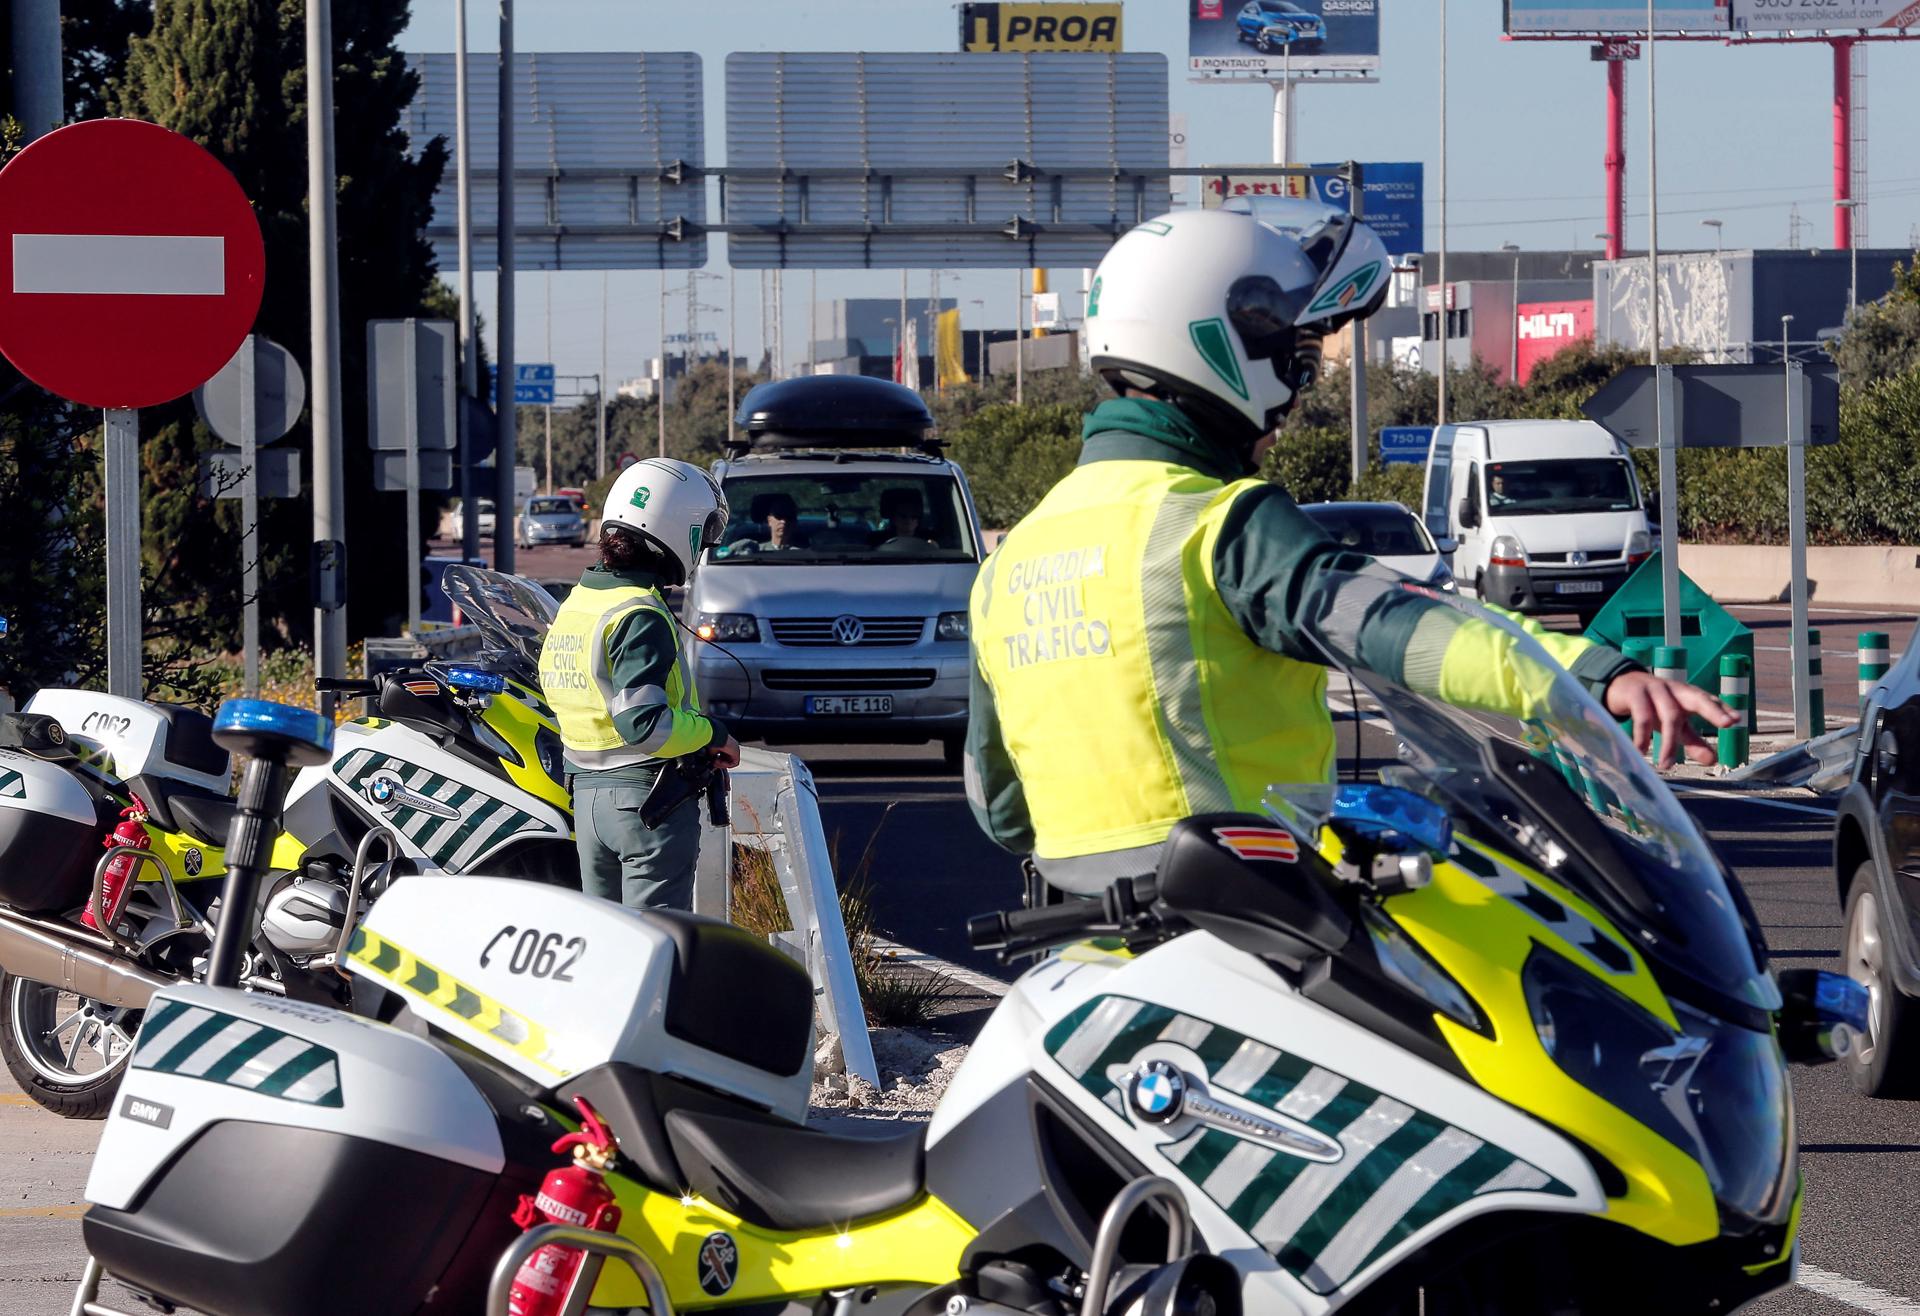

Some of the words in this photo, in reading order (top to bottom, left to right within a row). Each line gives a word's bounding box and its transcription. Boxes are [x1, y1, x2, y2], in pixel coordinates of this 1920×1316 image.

[1006, 16, 1117, 43] PROA
[1608, 43, 1637, 56] SPS
[1203, 59, 1266, 68] MONTAUTO
[1519, 313, 1574, 339] HILTI
[1392, 434, 1414, 444] 750
[1416, 435, 1426, 443] m
[1008, 546, 1104, 594] GUARDIA
[1024, 585, 1084, 627] CIVIL
[546, 634, 584, 652] GUARDIA
[1004, 620, 1109, 668] TRAFICO
[554, 652, 576, 671] CIVIL
[542, 671, 588, 689] TRAFICO
[814, 698, 832, 712] CE
[842, 698, 860, 712] TE
[863, 698, 890, 712] 118
[95, 713, 131, 738] 062
[509, 928, 587, 982] 062
[129, 1101, 161, 1121] BMW
